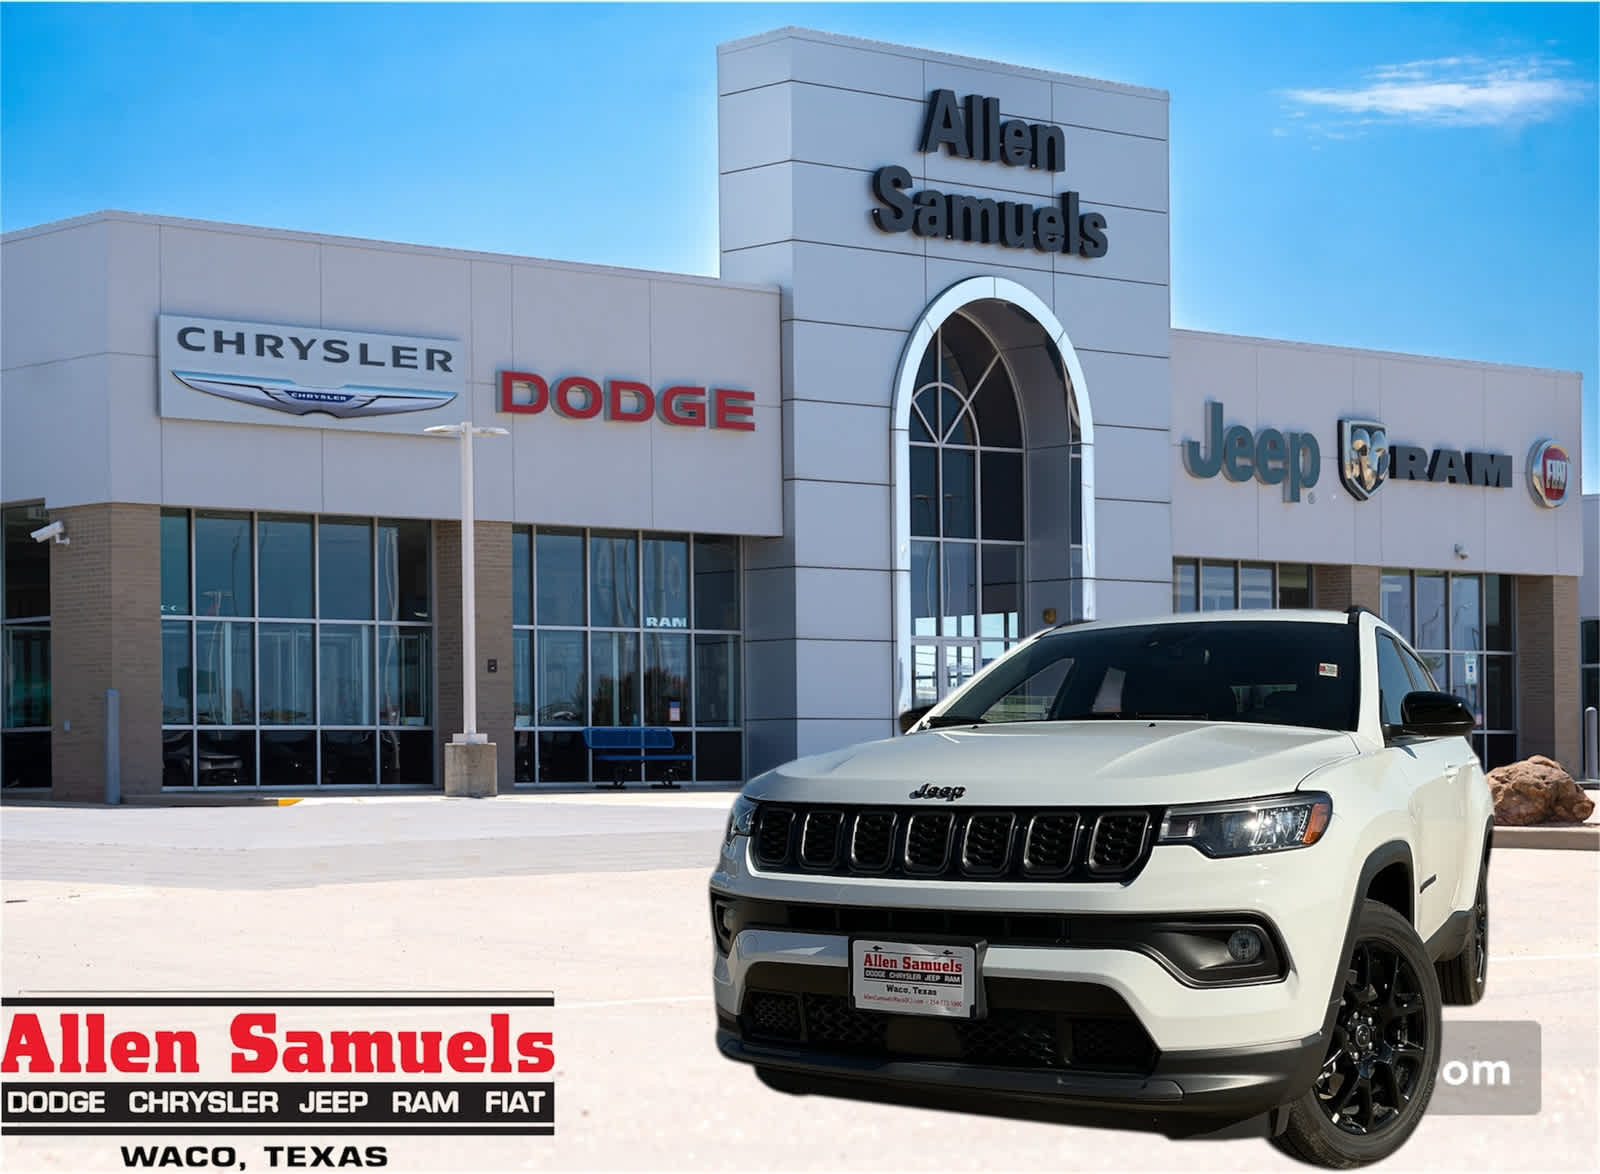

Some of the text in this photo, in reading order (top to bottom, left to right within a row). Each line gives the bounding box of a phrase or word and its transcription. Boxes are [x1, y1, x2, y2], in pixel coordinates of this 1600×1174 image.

[918, 88, 1066, 173] Allen
[871, 164, 1109, 258] Samuels
[176, 326, 454, 374] CHRYSLER
[290, 391, 347, 401] CHRYSLER
[496, 369, 756, 432] DODGE
[1183, 400, 1321, 503] Jeep
[1388, 444, 1513, 488] RAM
[1545, 458, 1567, 491] FIAT
[645, 616, 688, 628] RAM
[908, 783, 967, 802] Jeep
[863, 953, 963, 973] Allen Samuels
[865, 971, 961, 984] DODGE CHRYSLER JEEP RAM
[912, 986, 937, 996] Texas
